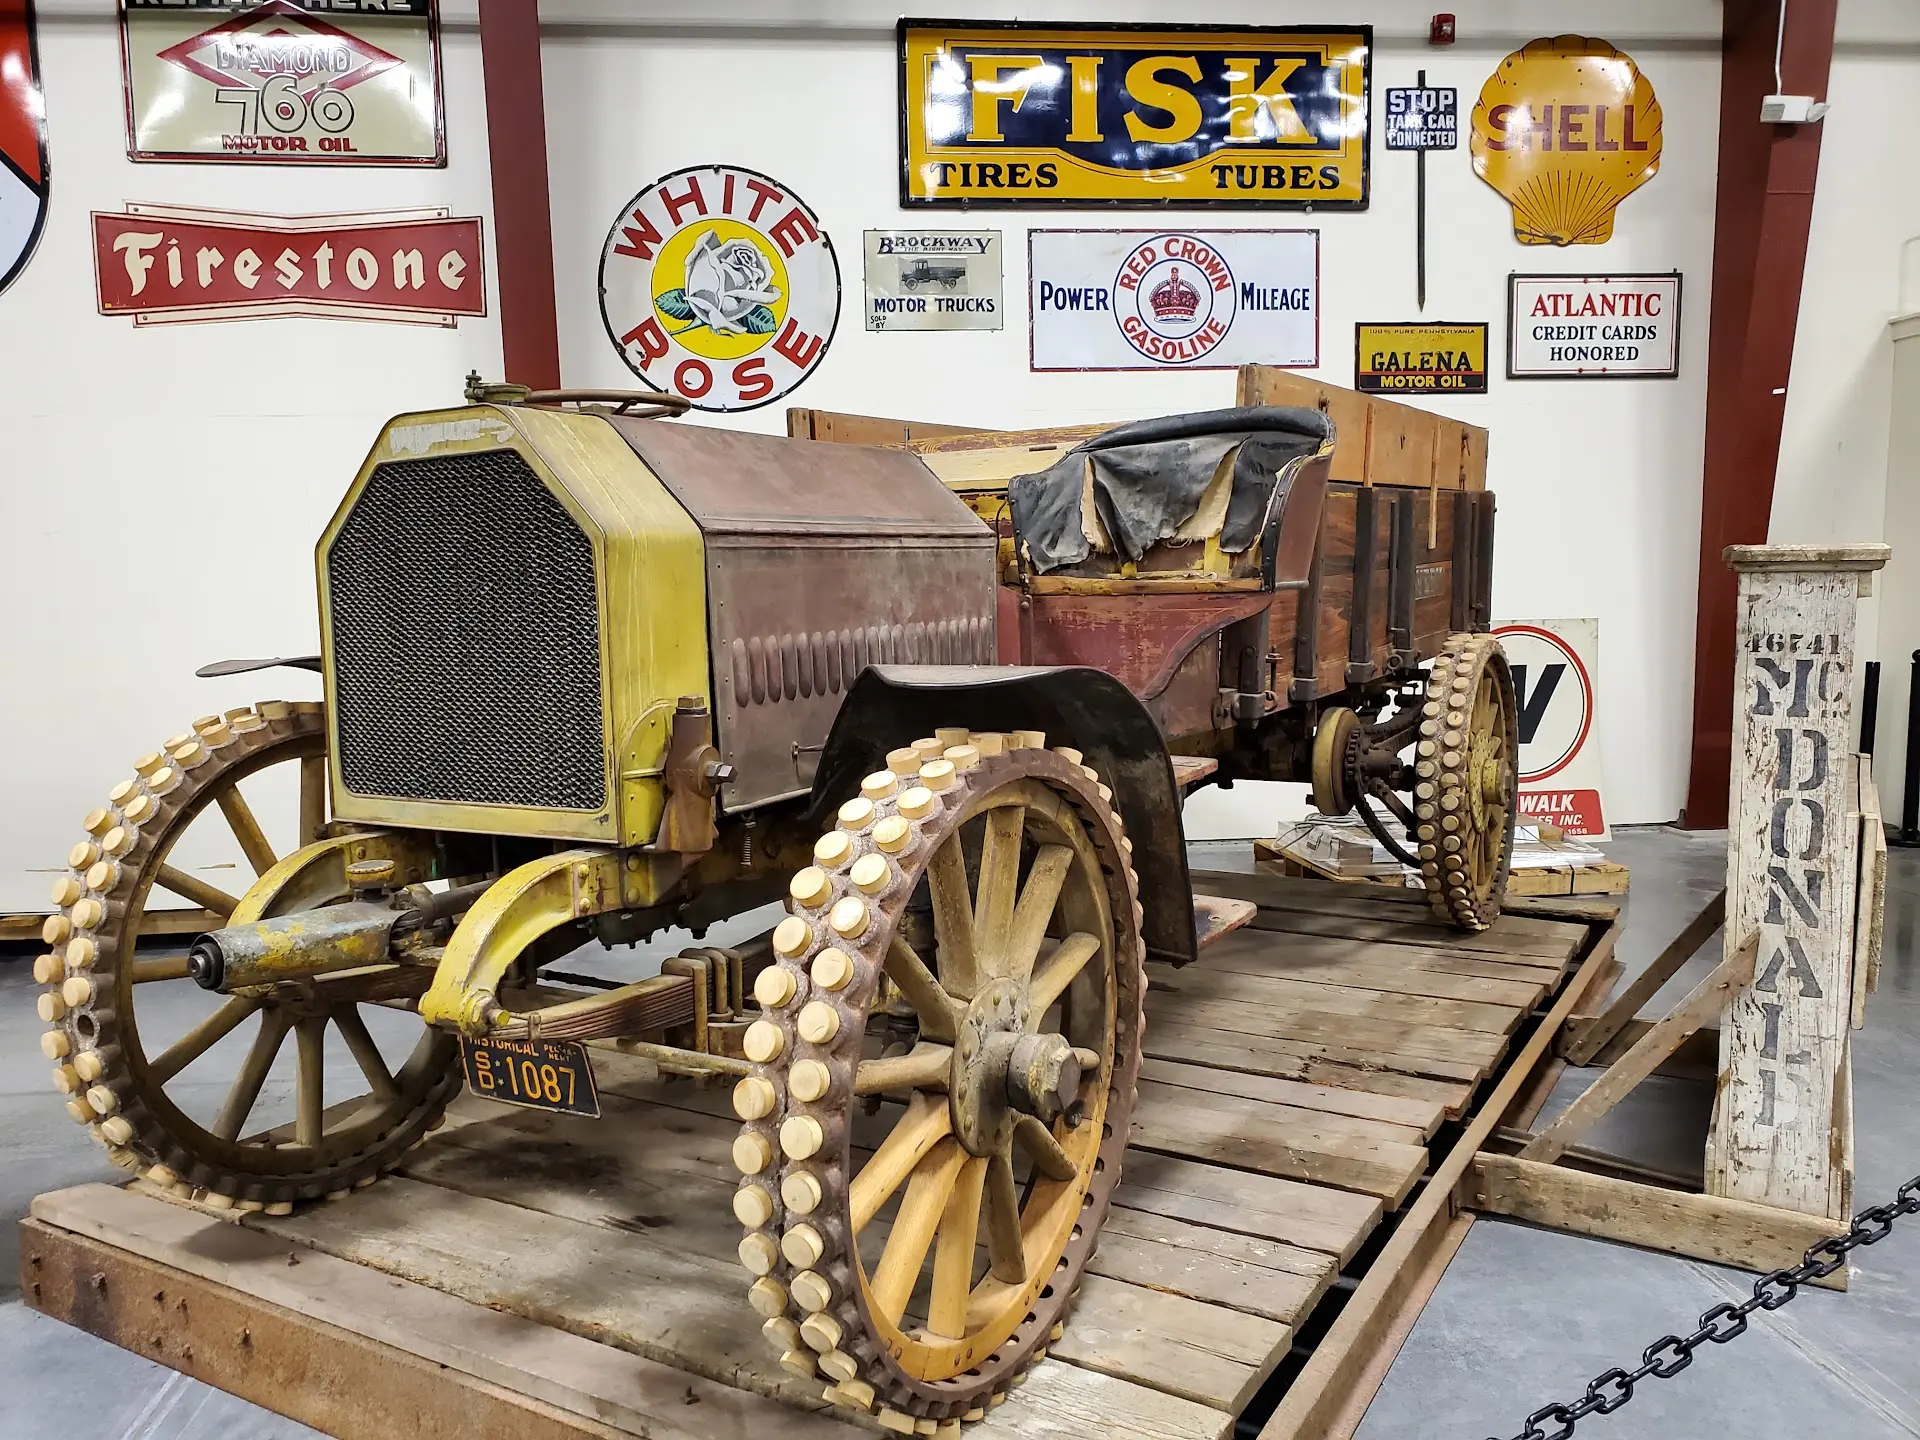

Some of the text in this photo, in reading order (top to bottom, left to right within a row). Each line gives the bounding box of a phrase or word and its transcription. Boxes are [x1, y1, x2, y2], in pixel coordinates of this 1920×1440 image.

[214, 42, 352, 74] DIAMOND
[214, 73, 355, 136] 760
[964, 53, 1318, 145] FISK
[1389, 90, 1454, 112] STOP
[1427, 114, 1456, 129] CAR
[1485, 104, 1648, 152] SHELL
[222, 134, 358, 152] MOTOR OIL
[1387, 130, 1456, 146] CONNECTED
[929, 162, 1340, 191] TIRES TUBES
[613, 174, 820, 261] WHITE
[877, 236, 994, 254] BROCKWAY
[113, 230, 468, 297] Firestone
[1119, 238, 1232, 293] RED CROWN
[874, 297, 996, 313] MOTOR TRUCKS
[1040, 280, 1110, 311] POWER
[1240, 282, 1311, 312] MILEAGE
[1530, 292, 1662, 318] ATLANTIC
[870, 315, 887, 324] SOLD
[875, 321, 886, 329] BY
[1123, 315, 1227, 361] GASOLINE
[1418, 328, 1476, 336] PENNSYLVANIA
[1532, 325, 1658, 341] CREDIT CARDS
[621, 316, 824, 401] ROSE
[1371, 350, 1473, 372] GALENA
[1549, 346, 1640, 362] HONORED
[1380, 375, 1467, 388] MOTOR OIL
[1744, 633, 1841, 655] 46741
[1517, 793, 1575, 813] WALK
[1559, 814, 1584, 826] INC.
[506, 1056, 576, 1106] 1087
